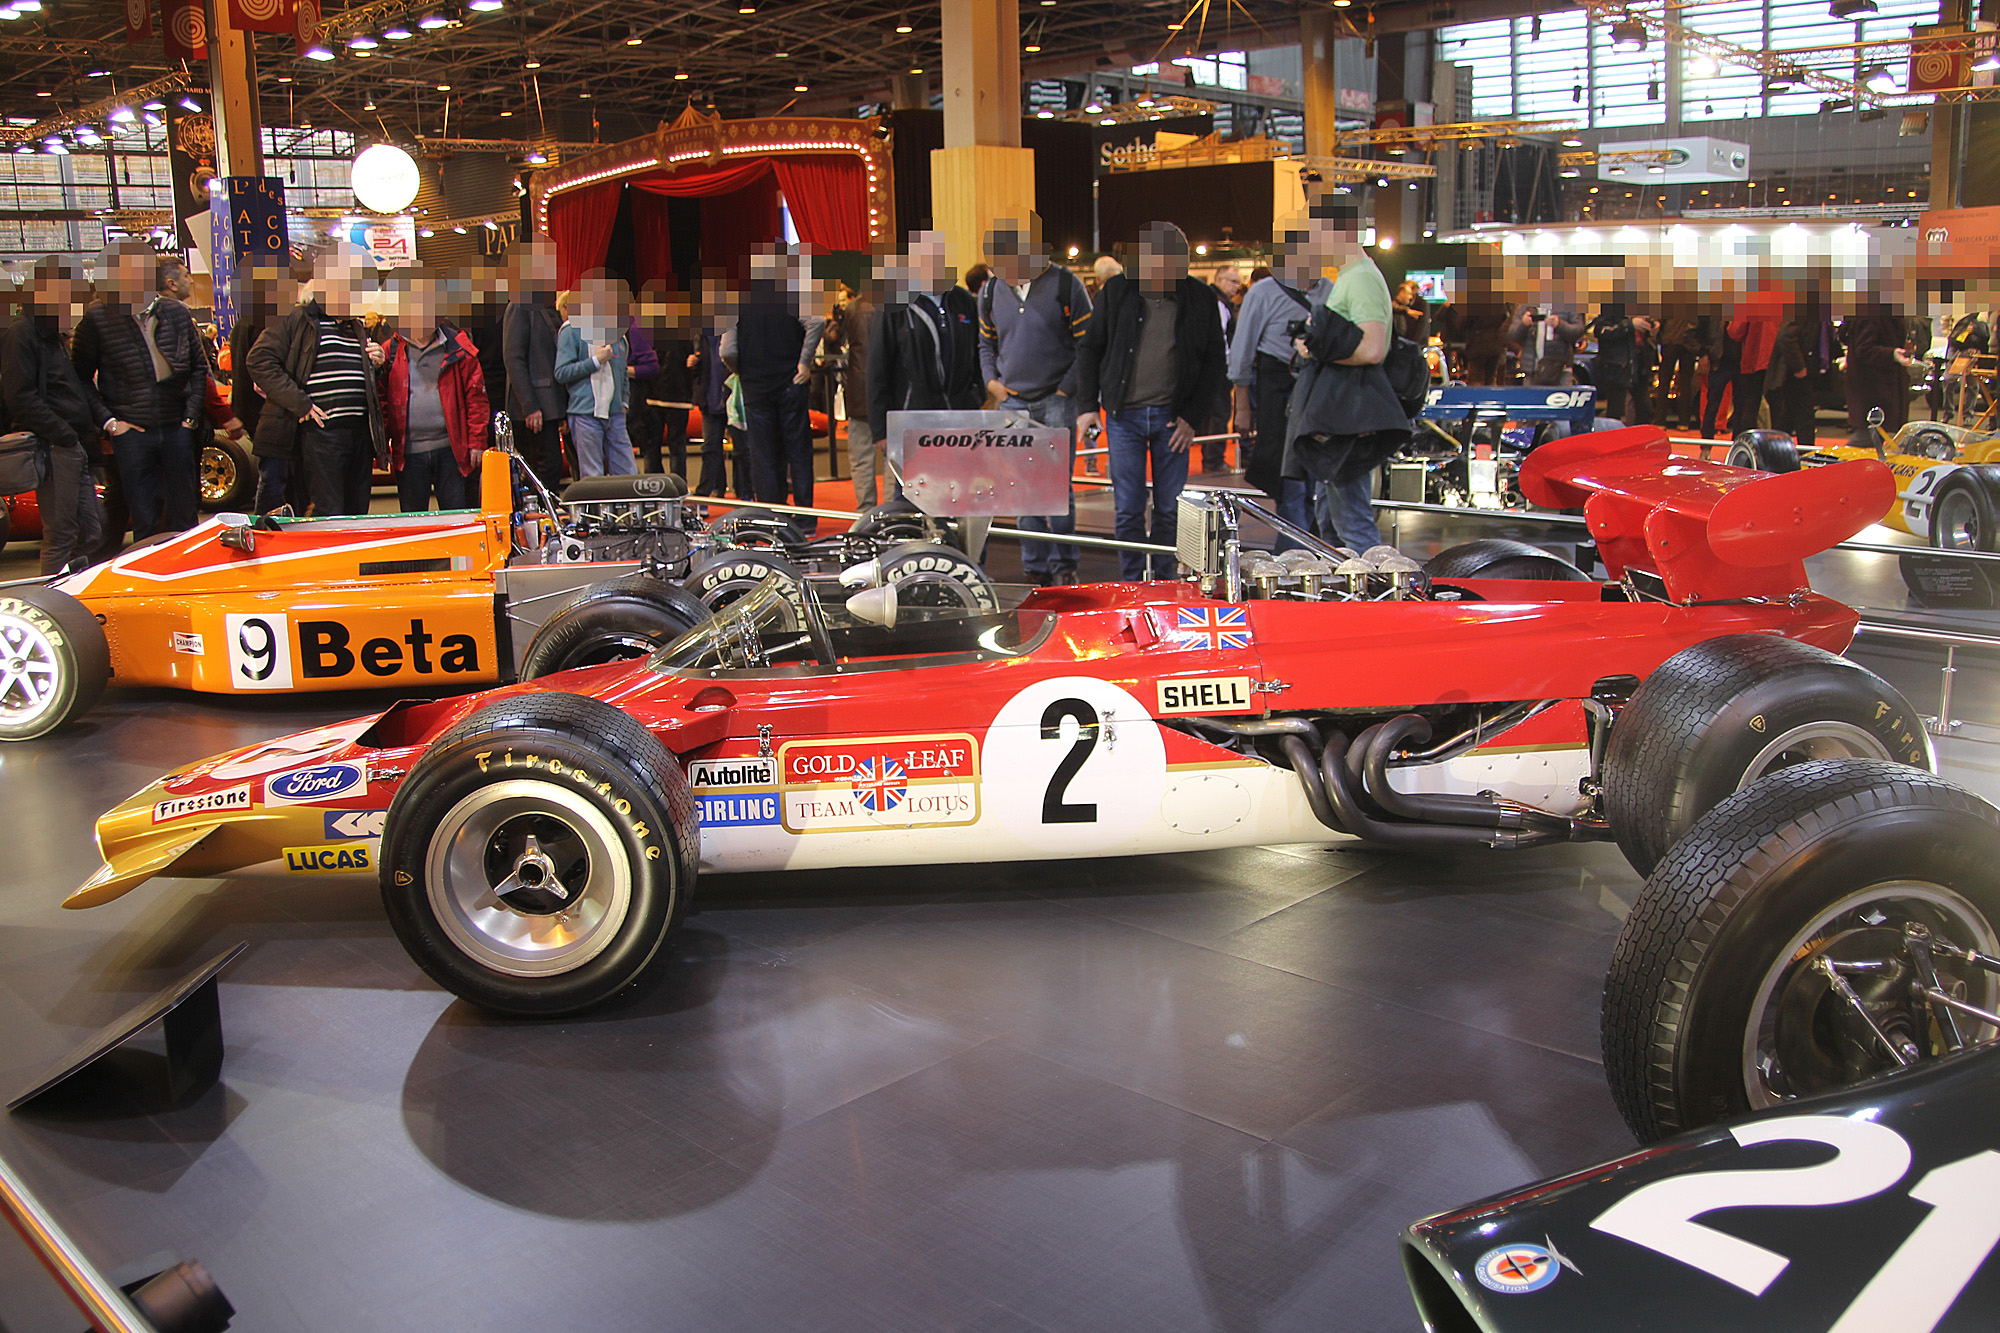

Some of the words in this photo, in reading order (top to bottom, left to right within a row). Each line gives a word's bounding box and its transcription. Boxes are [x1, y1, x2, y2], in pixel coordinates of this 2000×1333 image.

[373, 238, 407, 254] 24
[1546, 391, 1592, 408] elf
[176, 638, 202, 648] CHAMPION
[239, 618, 277, 681] 9
[298, 618, 481, 679] Beta
[1163, 682, 1246, 709] SHELL
[793, 754, 856, 775] GOLD
[906, 749, 965, 770] LEAF
[1040, 697, 1100, 824] 2
[286, 767, 344, 794] Ford
[694, 765, 771, 786] Autolite
[159, 790, 247, 818] Firestone
[475, 747, 661, 862] Firestone
[795, 801, 856, 819] TEAM
[907, 795, 969, 813] LOTUS
[287, 849, 370, 871] LUCAS
